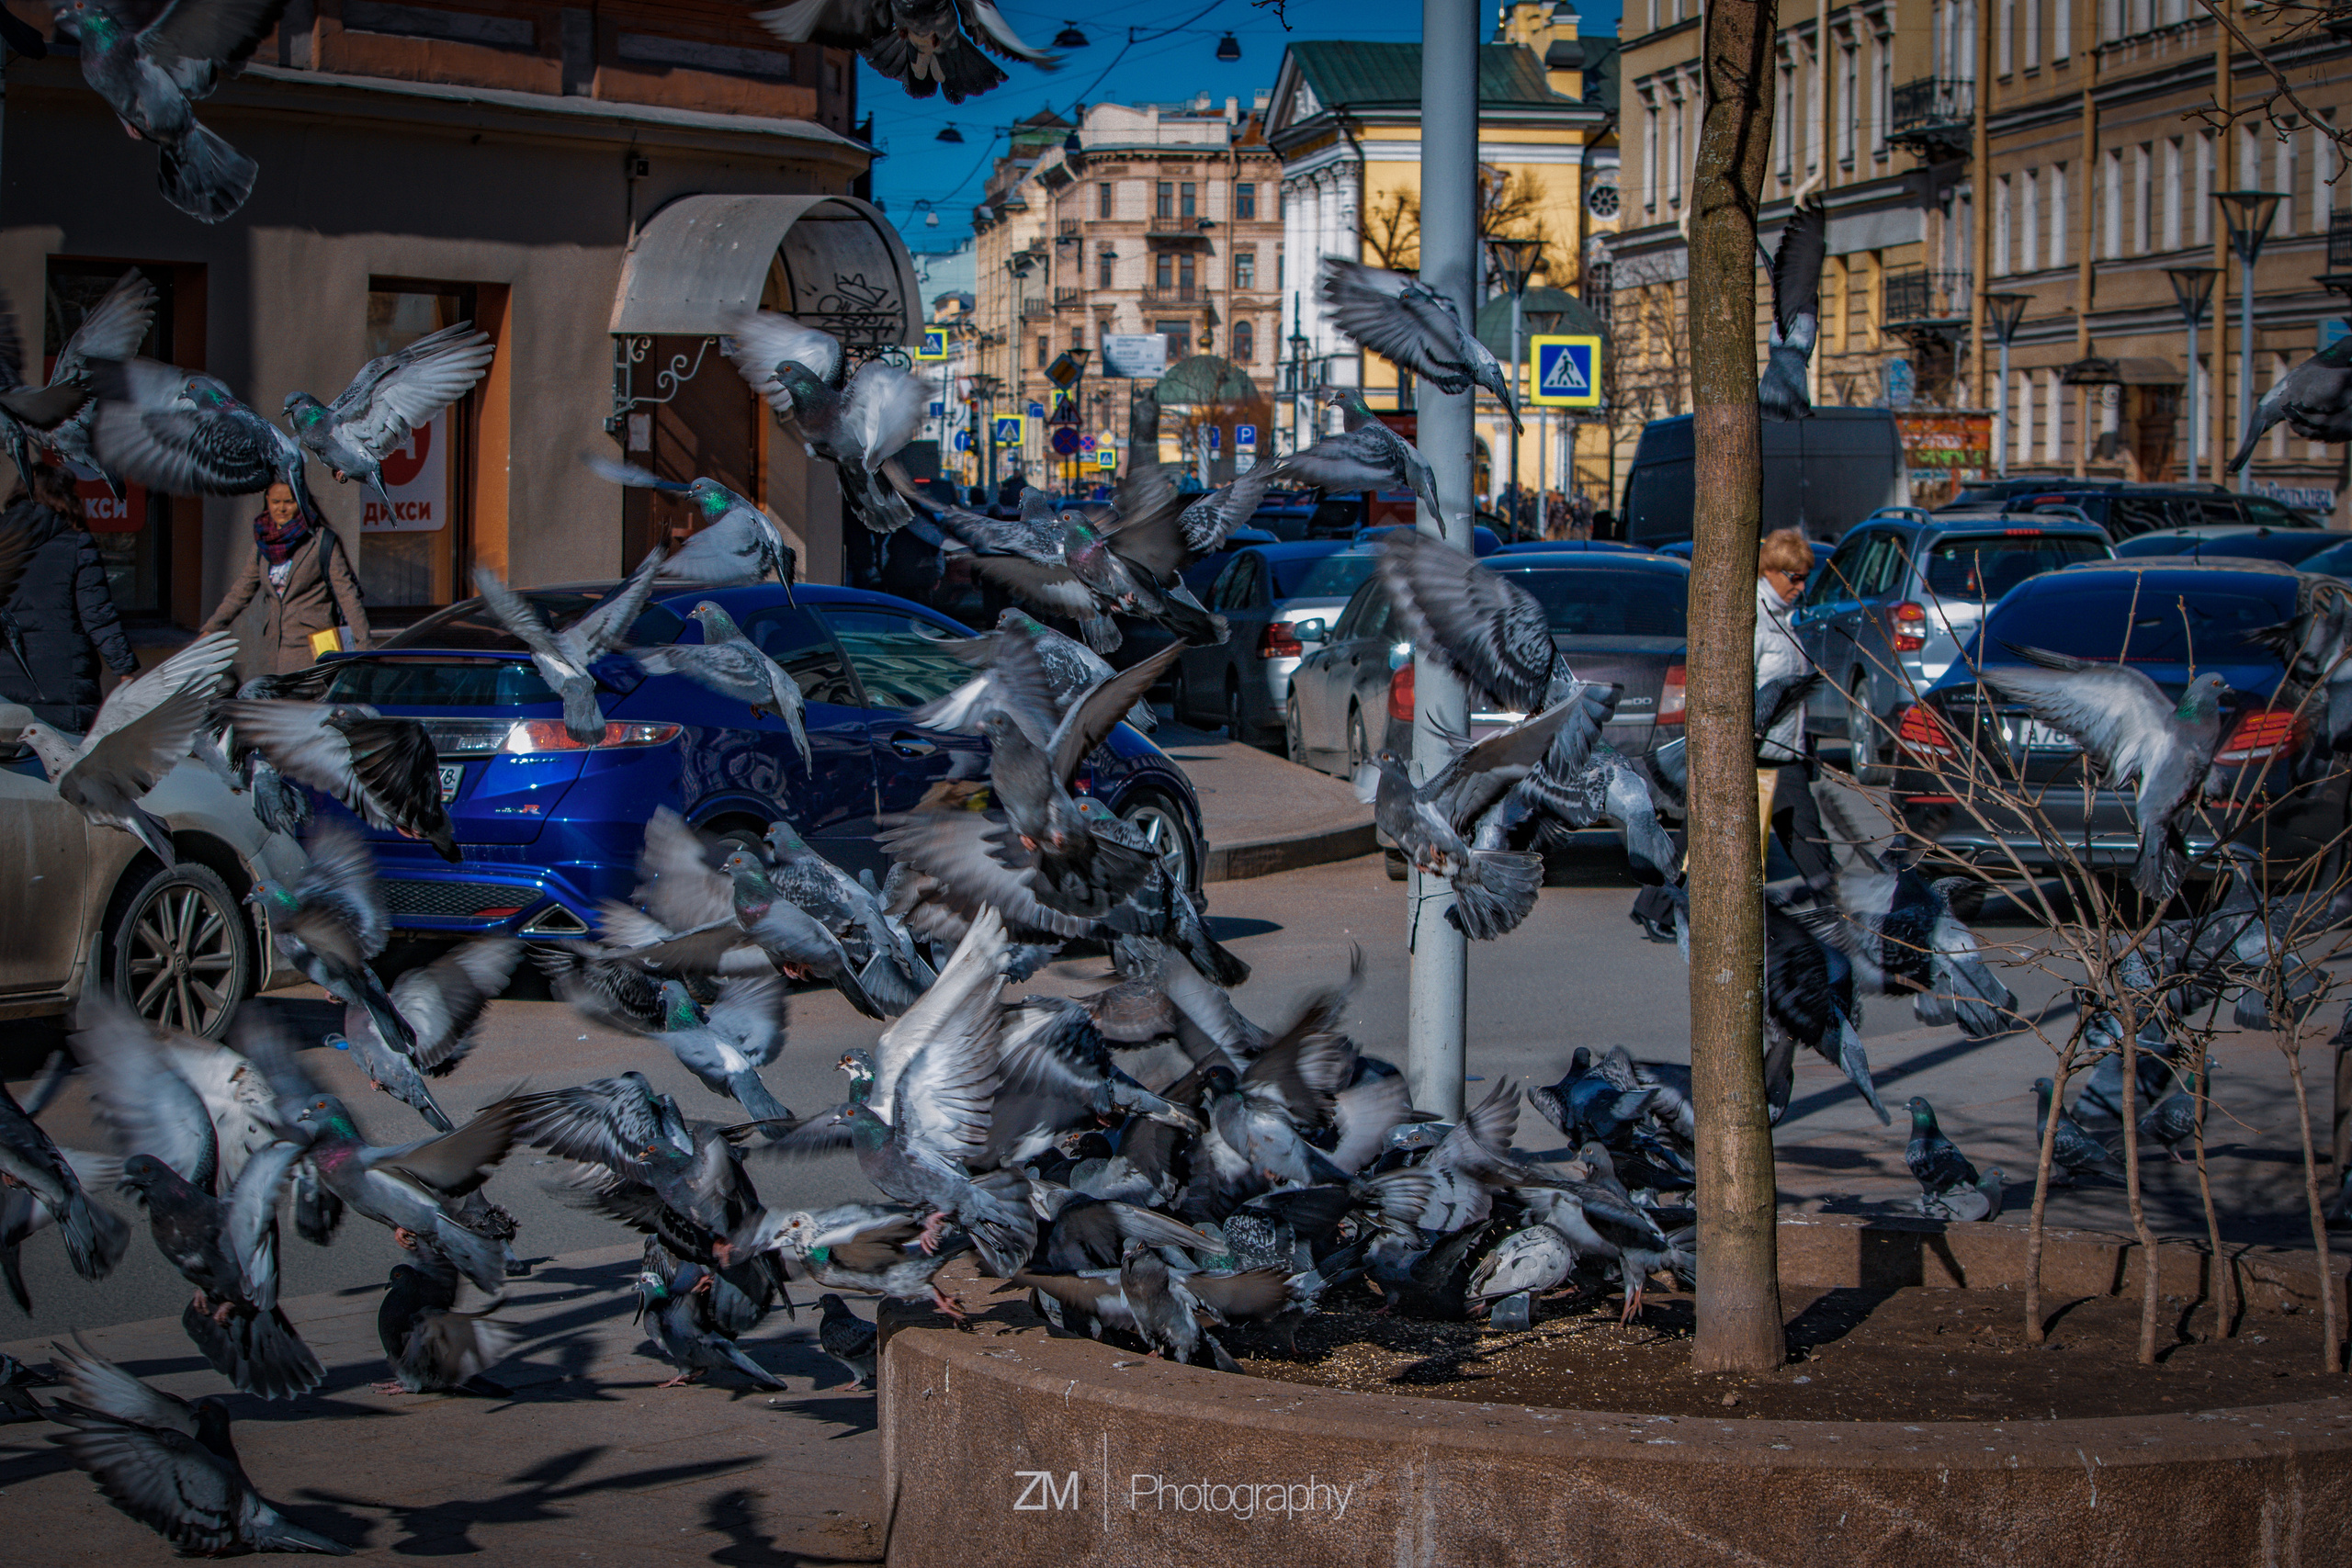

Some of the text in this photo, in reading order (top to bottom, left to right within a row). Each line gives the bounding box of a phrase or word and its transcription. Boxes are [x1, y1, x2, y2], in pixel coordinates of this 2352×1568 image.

[1241, 428, 1252, 442] P
[80, 498, 128, 519] КСИ
[363, 502, 431, 525] ДИКСИ
